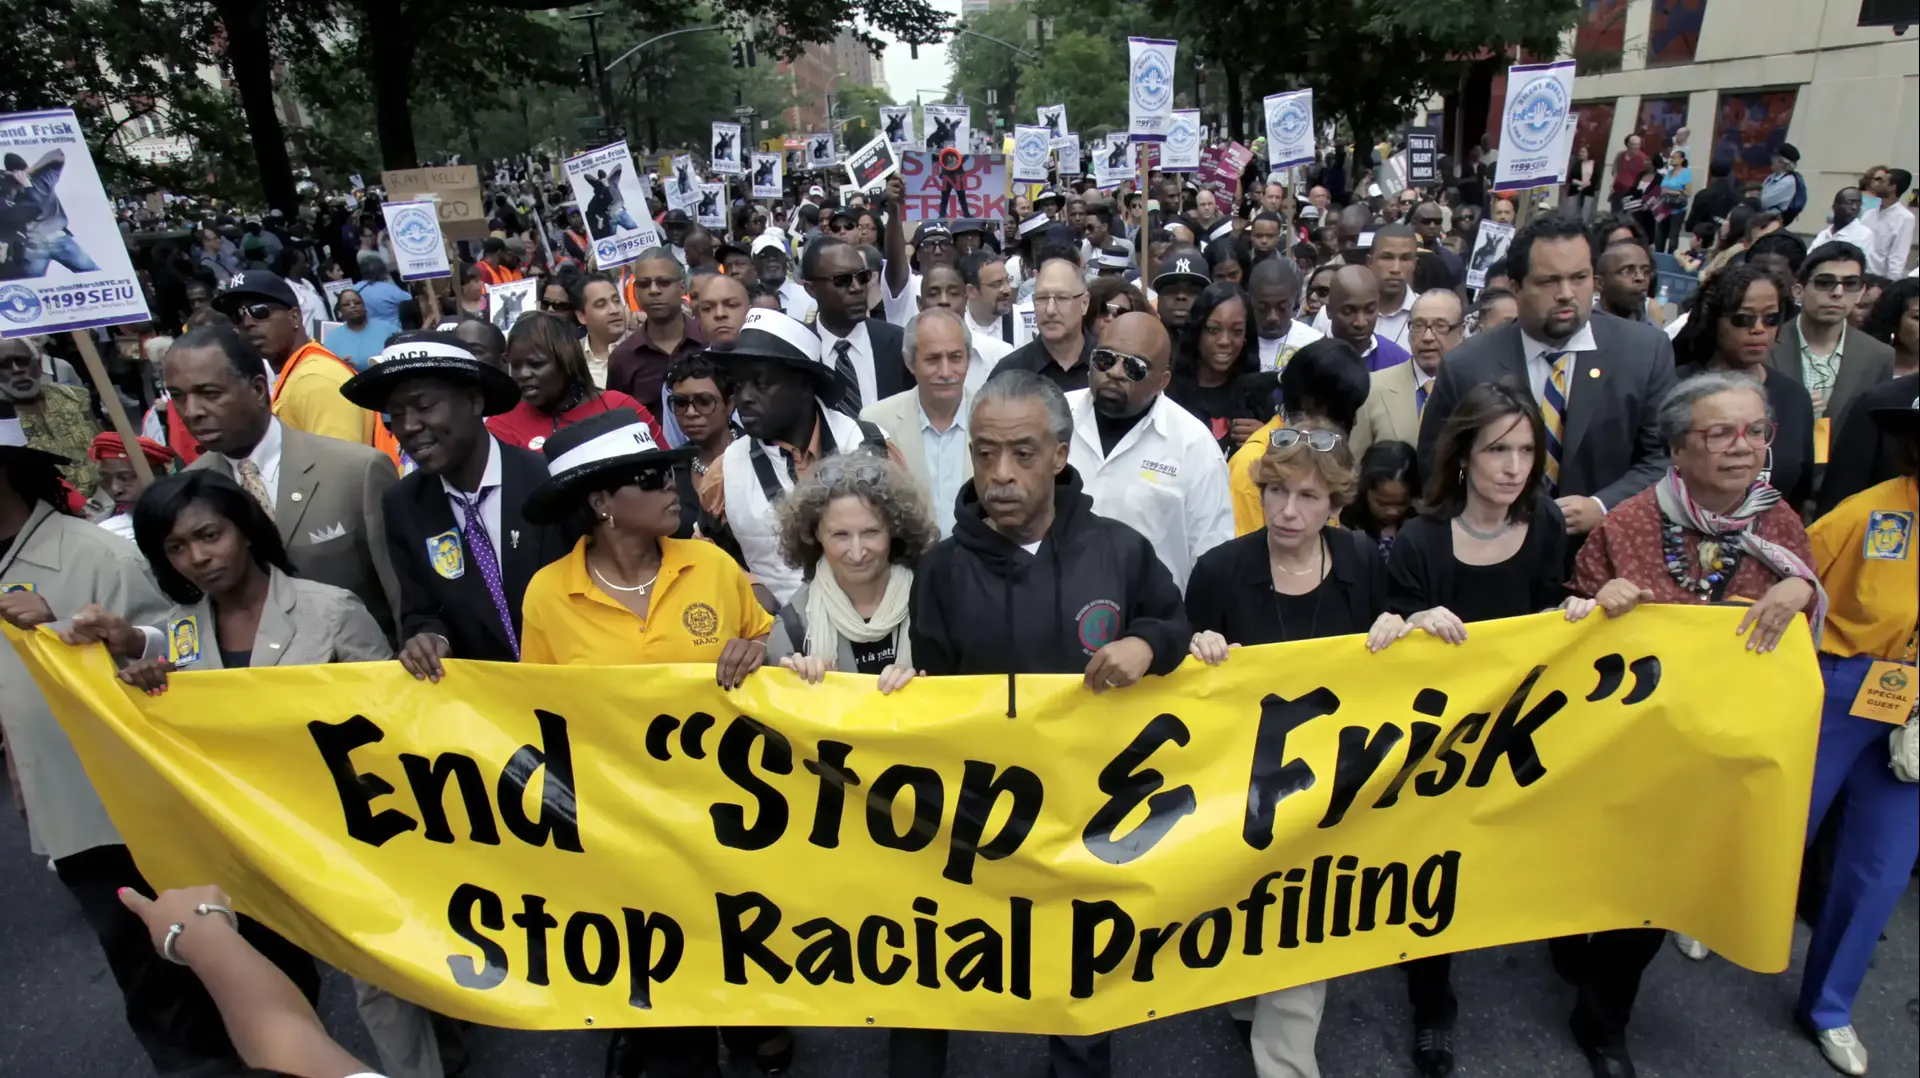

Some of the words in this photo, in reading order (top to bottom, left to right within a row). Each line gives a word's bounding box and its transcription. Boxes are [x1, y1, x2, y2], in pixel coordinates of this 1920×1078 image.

[0, 126, 27, 138] and
[31, 122, 74, 136] Frisk
[1410, 138, 1422, 149] THIS
[1423, 138, 1429, 149] IS
[1430, 139, 1434, 149] A
[608, 148, 626, 158] Frisk
[852, 148, 875, 169] MARCH
[874, 141, 884, 151] TO
[1412, 153, 1431, 163] SILENT
[864, 155, 878, 169] END
[1510, 160, 1548, 171] 1199SEIU
[1412, 167, 1432, 178] MARCH
[389, 173, 418, 188] RAY
[432, 171, 466, 184] KELLY
[921, 174, 983, 191] AND
[900, 194, 1006, 221] FRISK
[42, 285, 134, 309] 1199SEIU
[385, 350, 428, 361] AACP
[1142, 460, 1177, 474] 1199SEIU
[692, 637, 719, 646] NAACP
[868, 652, 875, 661] is
[1866, 689, 1907, 702] SPECIAL
[1866, 699, 1900, 710] GUEST
[307, 709, 585, 853] End
[645, 711, 1044, 885] “Stop
[1082, 713, 1197, 864] &
[1243, 653, 1661, 850] Frisk”
[446, 883, 684, 1010] Stop
[715, 891, 1033, 1000] Racial
[1070, 850, 1461, 999] Profiling
